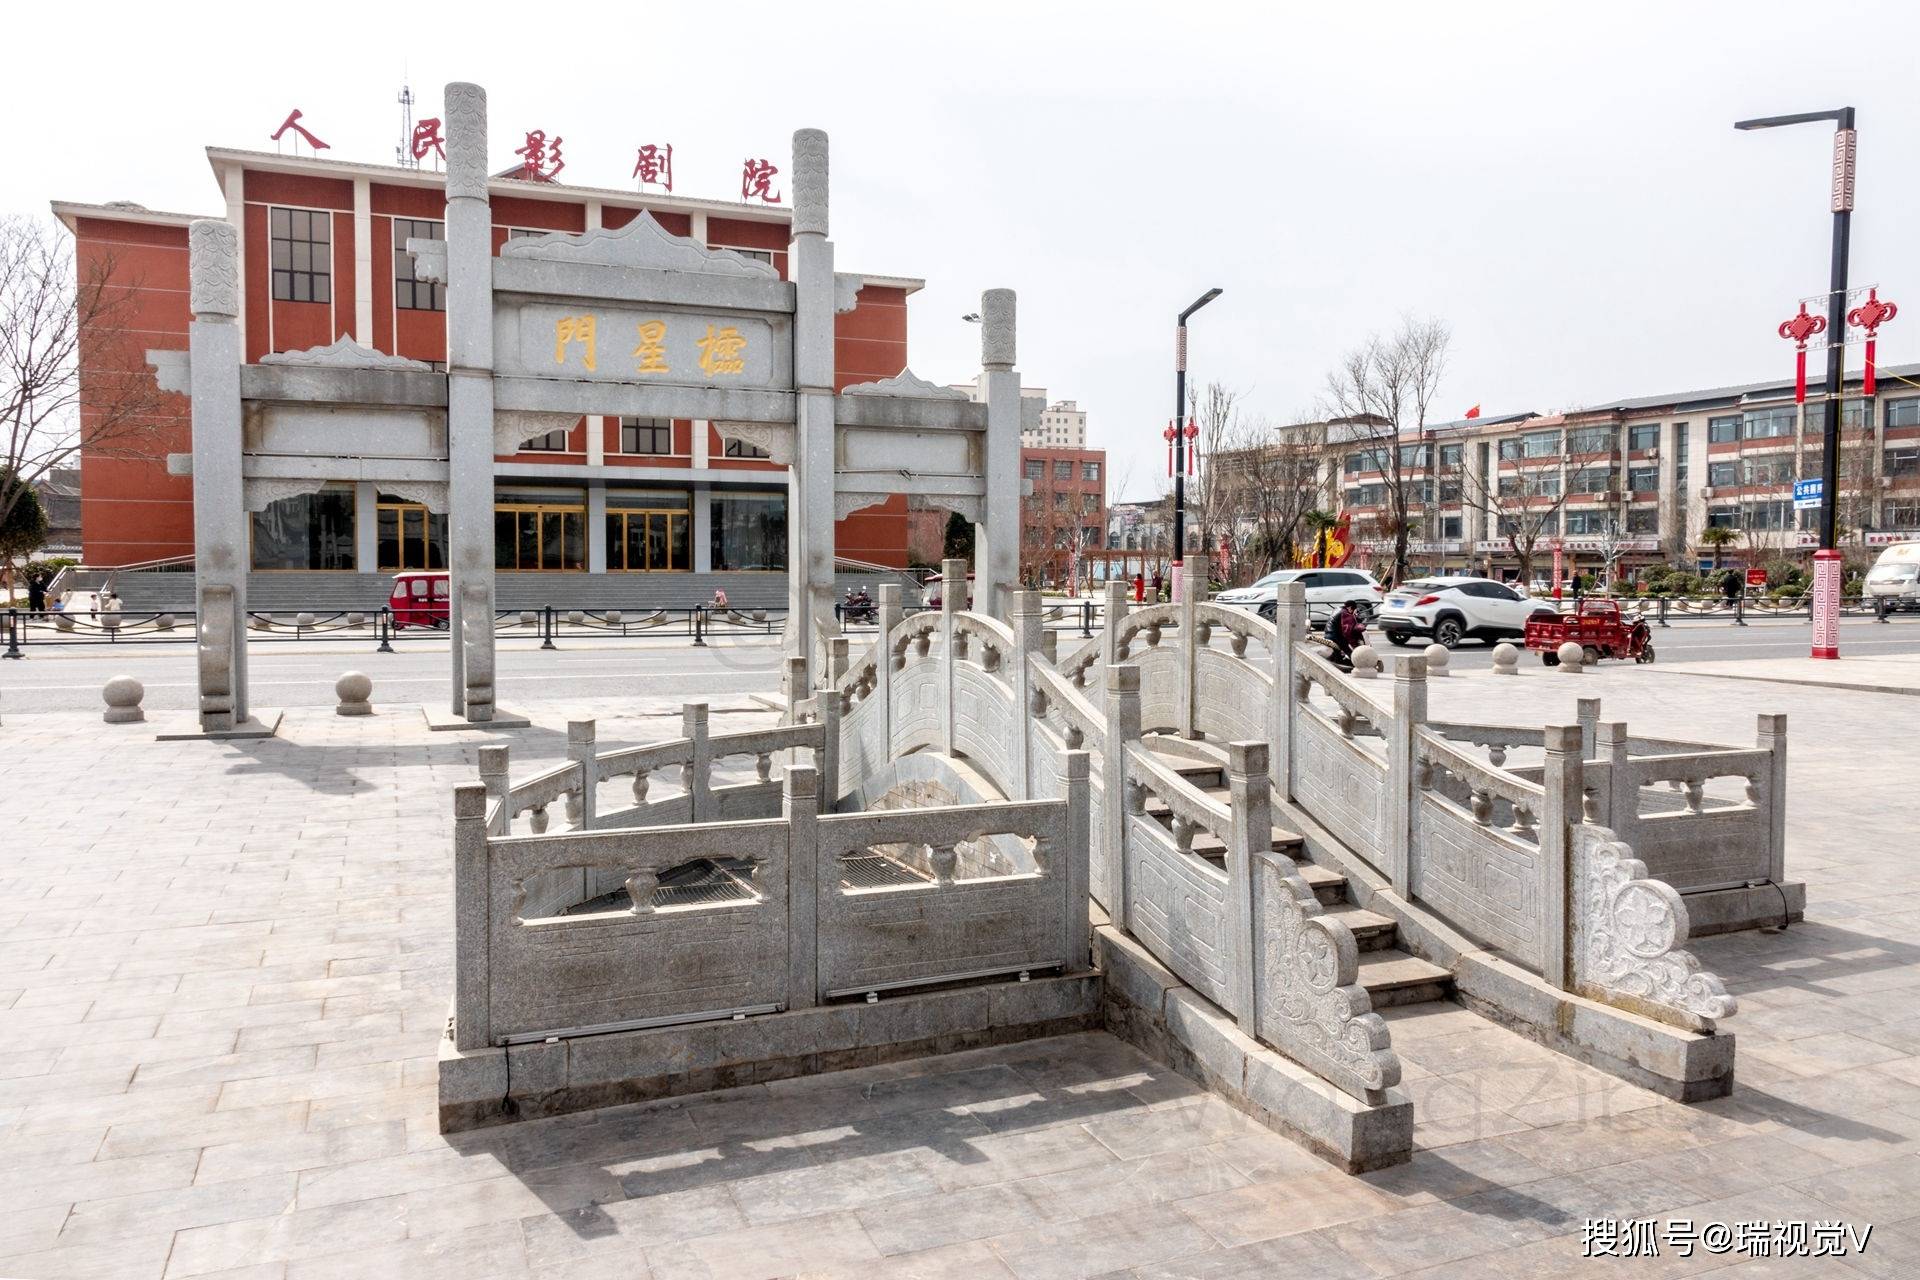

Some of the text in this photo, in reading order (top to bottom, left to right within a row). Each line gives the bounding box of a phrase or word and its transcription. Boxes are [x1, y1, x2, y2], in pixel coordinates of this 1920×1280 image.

[270, 108, 782, 204] 人民影剧院
